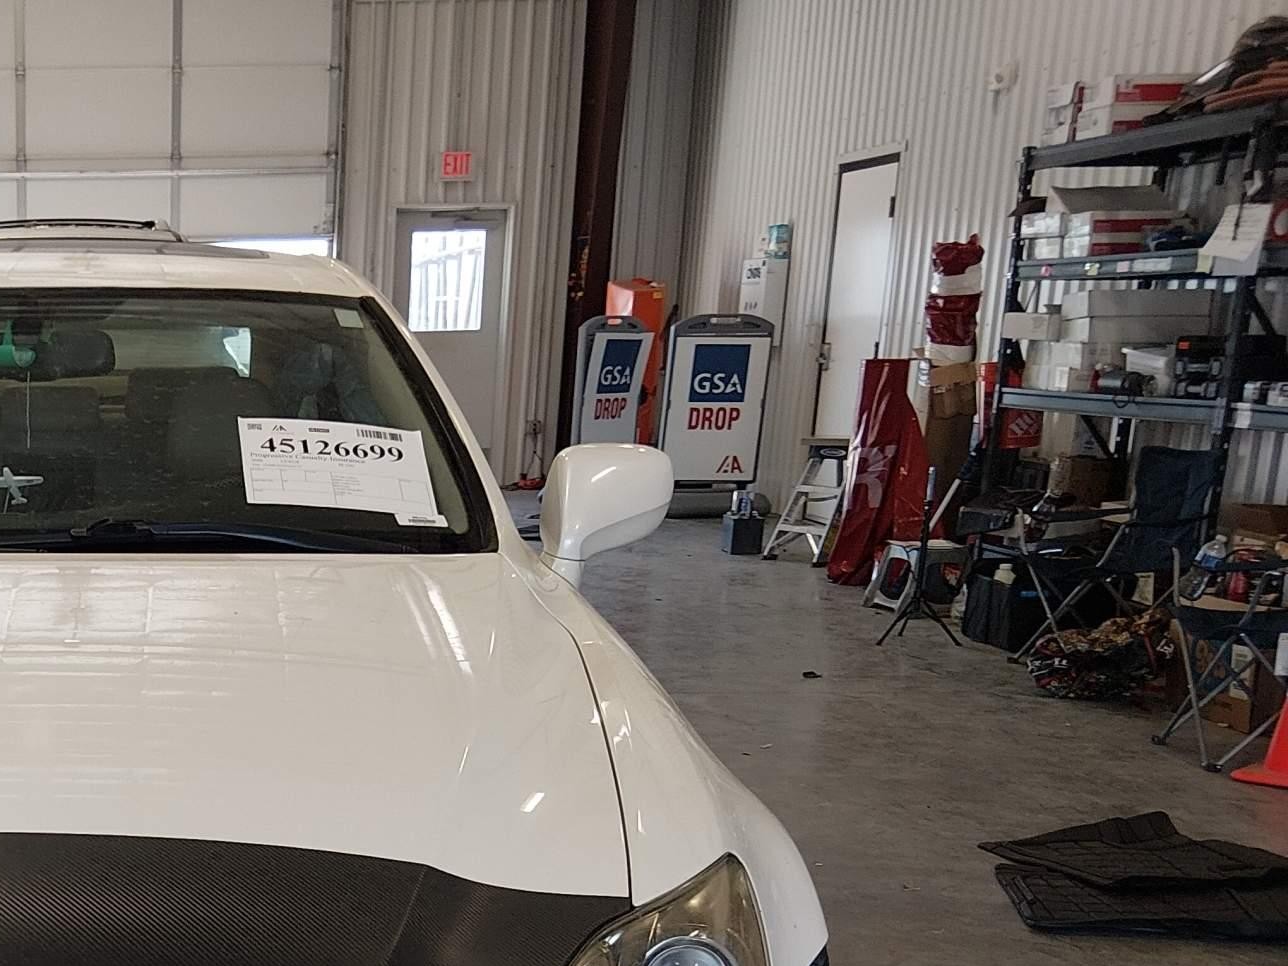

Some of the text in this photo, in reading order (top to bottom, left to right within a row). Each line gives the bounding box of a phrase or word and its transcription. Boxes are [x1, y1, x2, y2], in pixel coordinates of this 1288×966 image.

[444, 153, 472, 175] EXIT
[600, 365, 631, 385] GSA
[693, 372, 743, 394] GSA
[594, 397, 627, 420] DROP
[688, 407, 740, 430] DROP
[260, 437, 403, 463] 45126699
